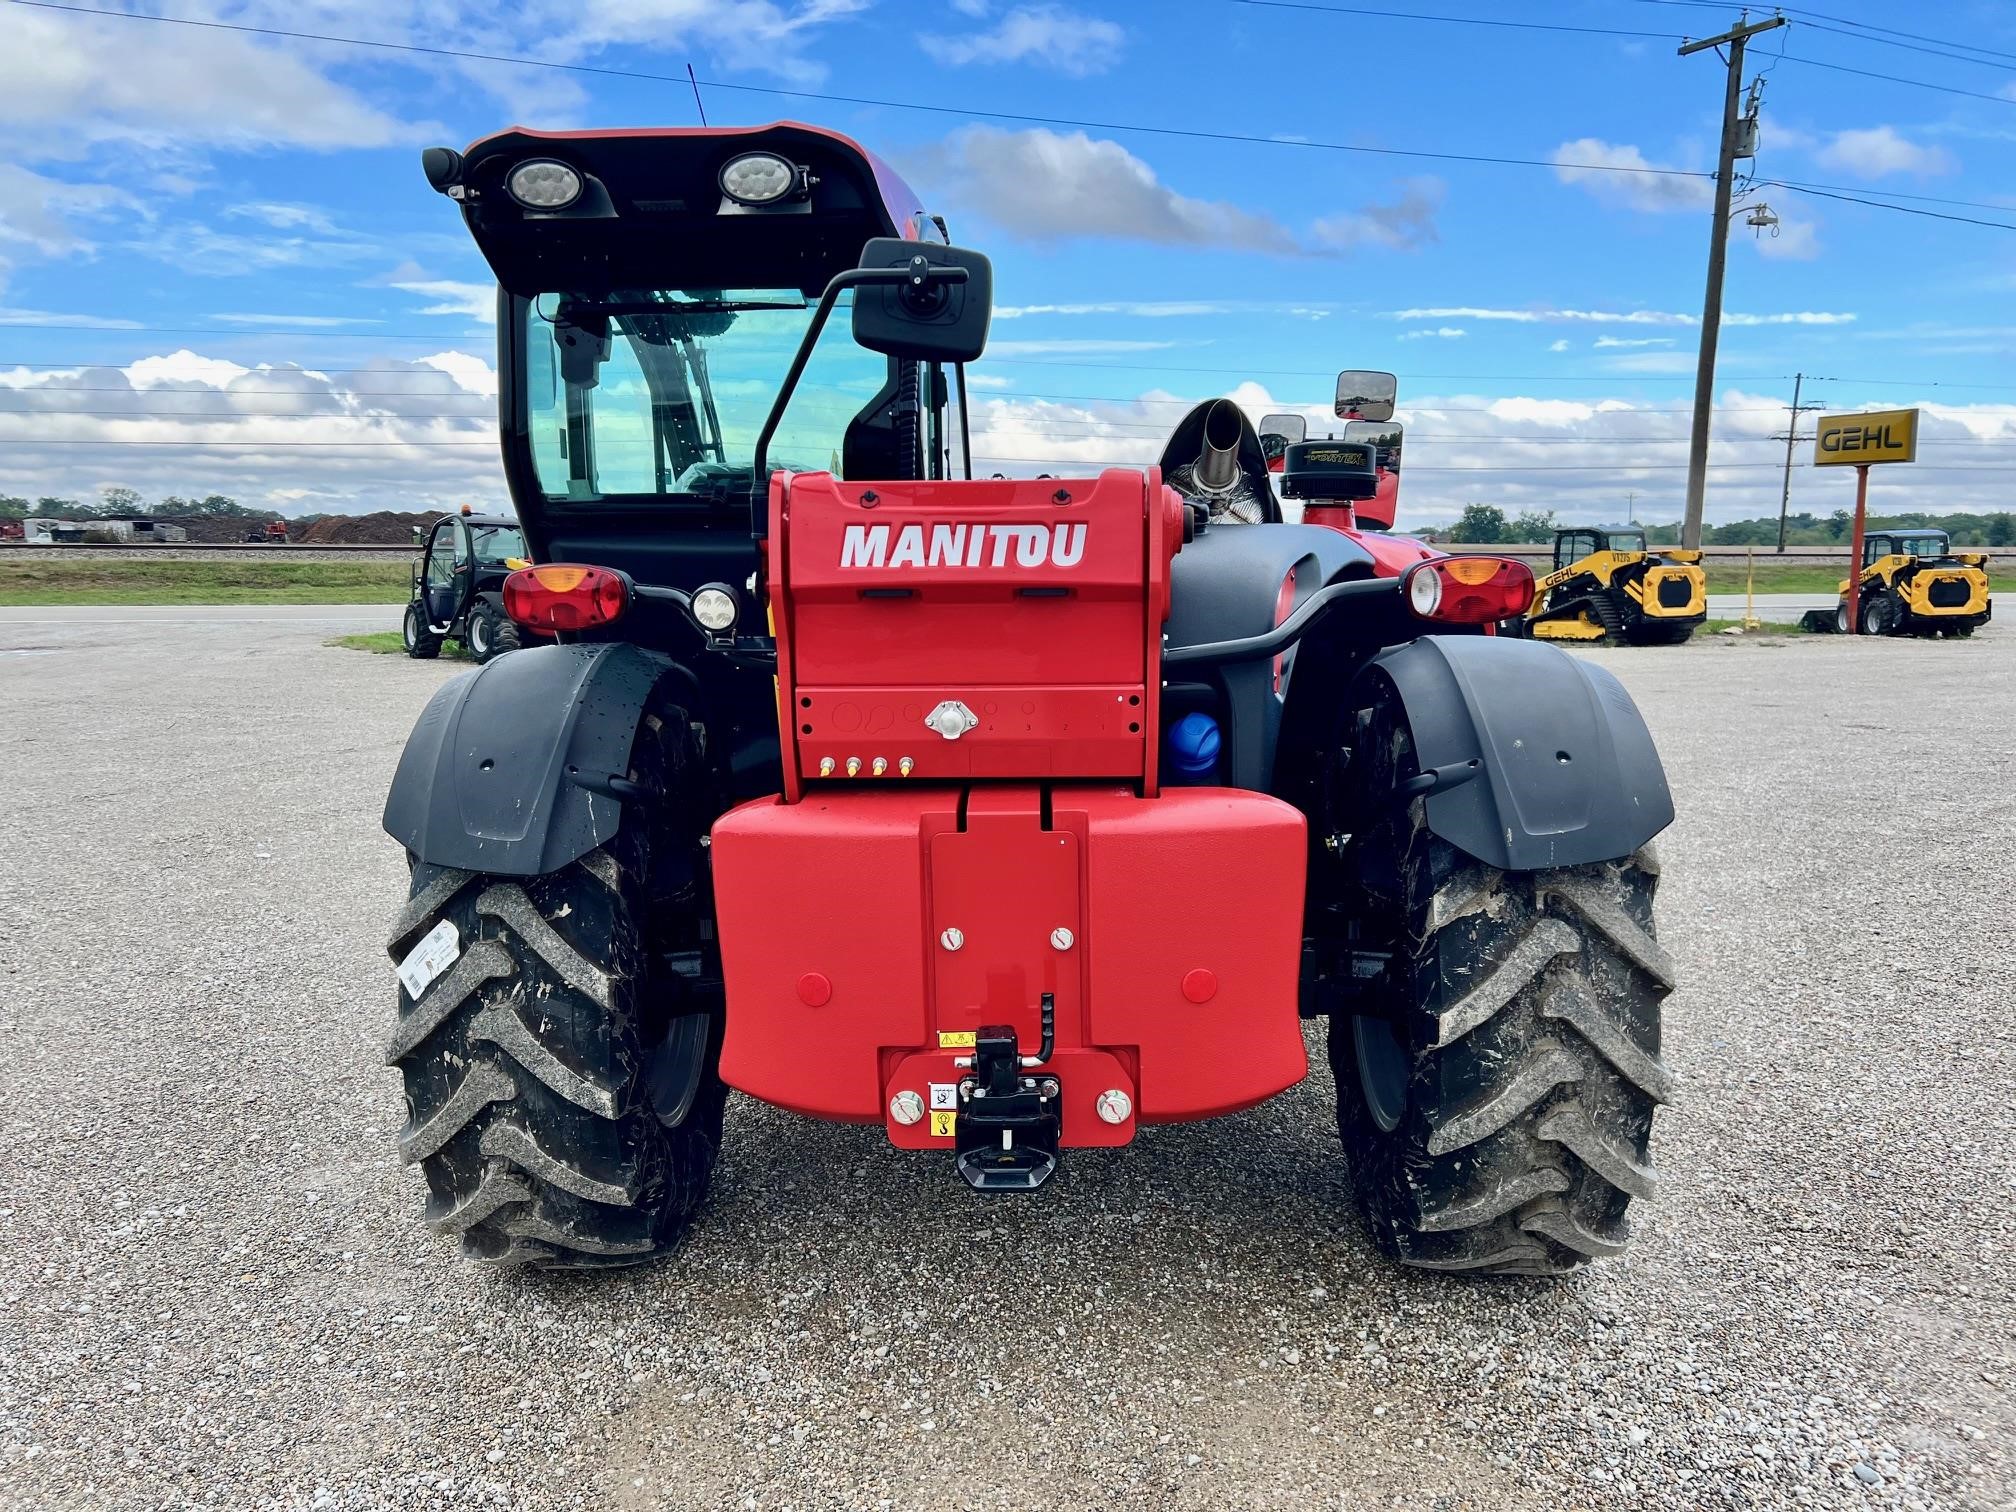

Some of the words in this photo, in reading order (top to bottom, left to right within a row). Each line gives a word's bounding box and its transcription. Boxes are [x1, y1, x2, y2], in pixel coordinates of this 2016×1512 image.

[1821, 425, 1902, 452] GEHL
[1311, 453, 1362, 465] VORTEX
[840, 524, 1087, 568] MANITOU
[1545, 567, 1577, 586] GEHL
[1858, 568, 1875, 583] EHL
